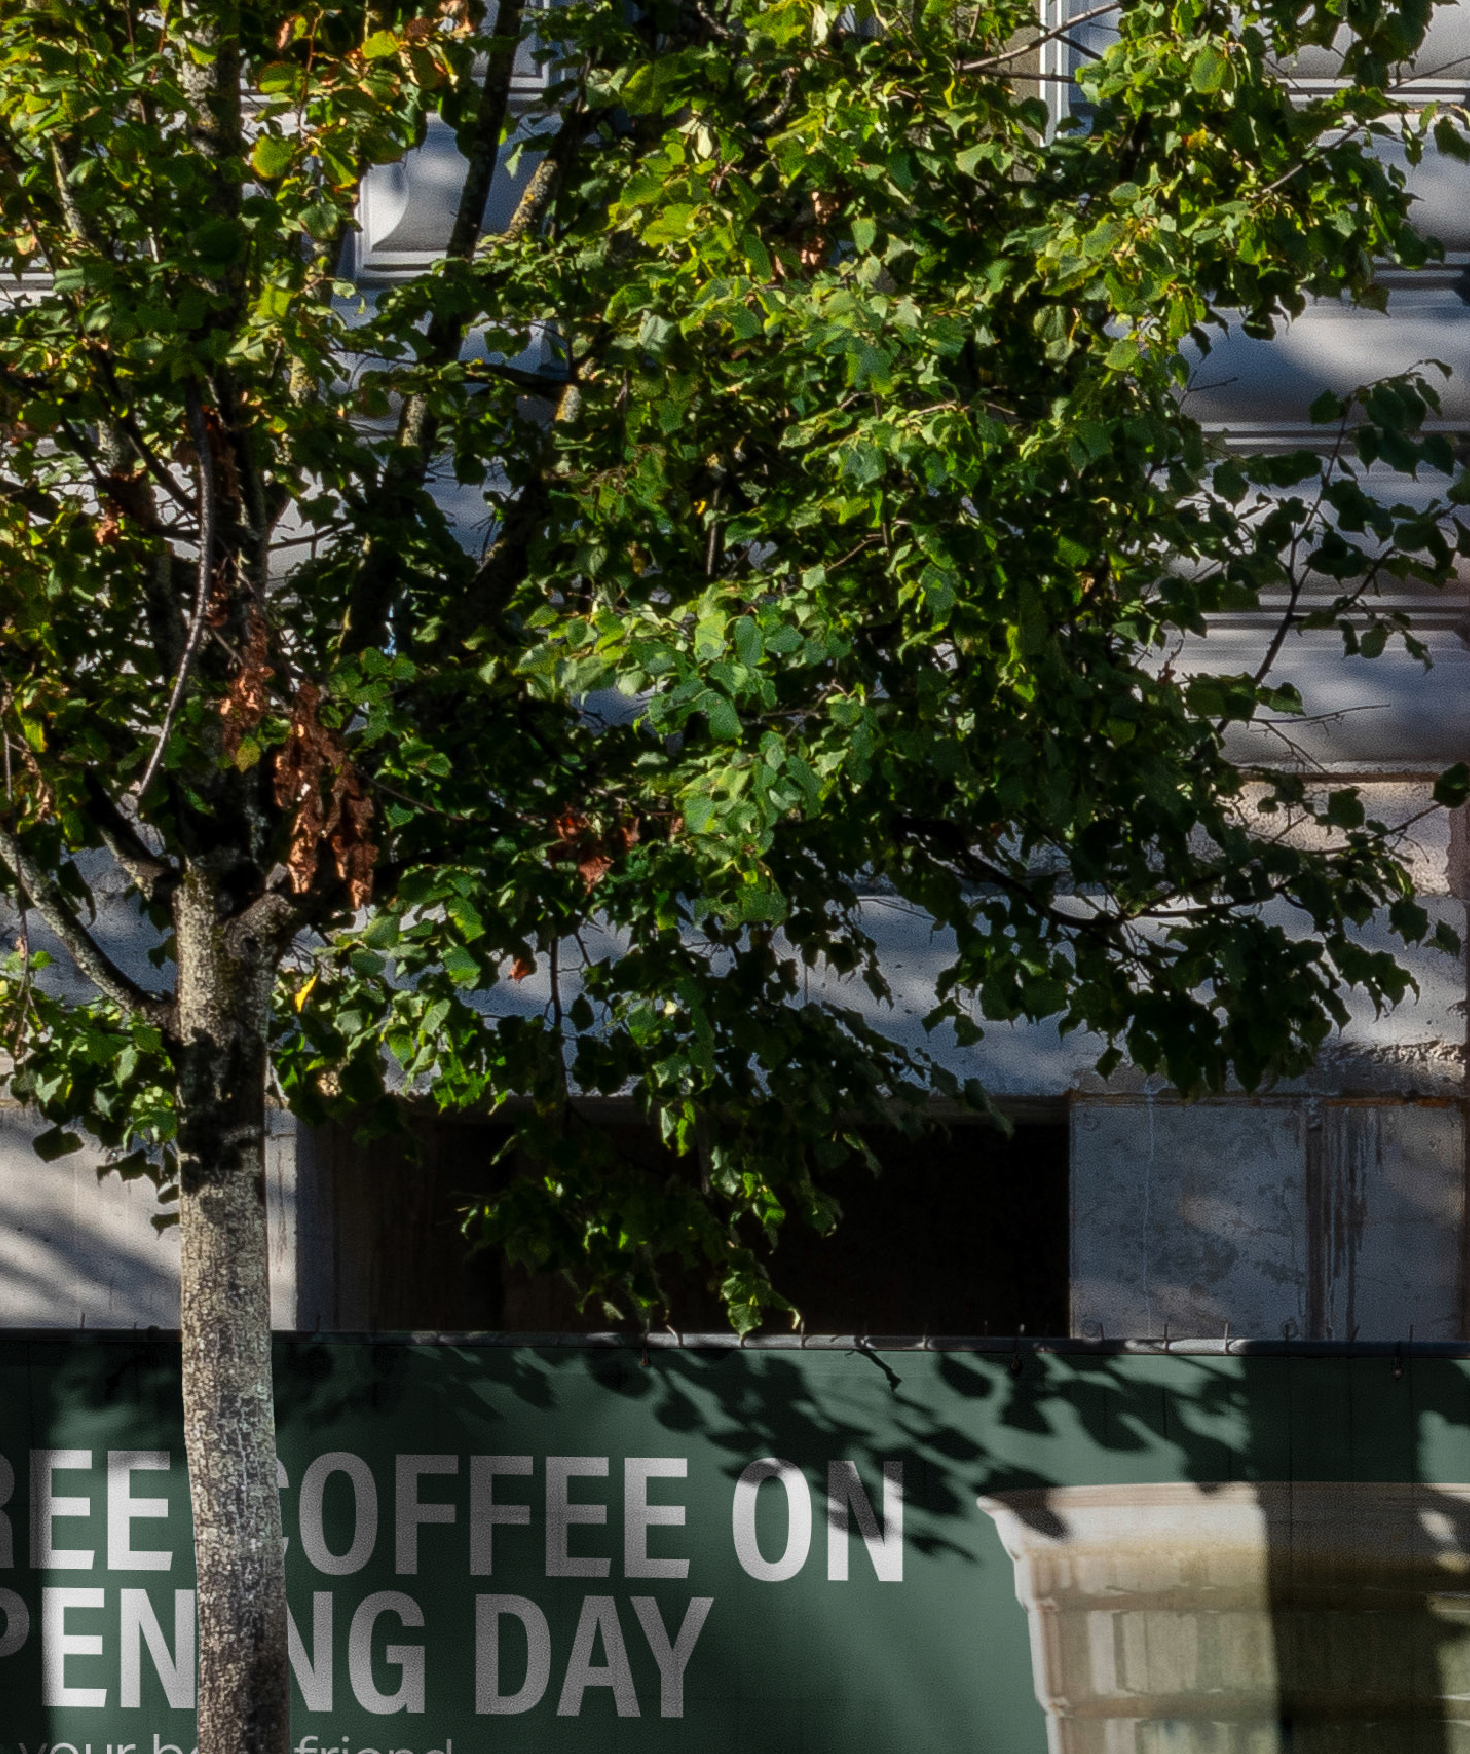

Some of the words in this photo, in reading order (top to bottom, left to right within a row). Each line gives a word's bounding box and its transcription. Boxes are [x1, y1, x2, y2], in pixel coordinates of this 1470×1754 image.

[0, 1449, 174, 1572] EE
[275, 1451, 690, 1580] OFFEE
[732, 1456, 905, 1583] ON
[475, 1592, 715, 1719] DAY
